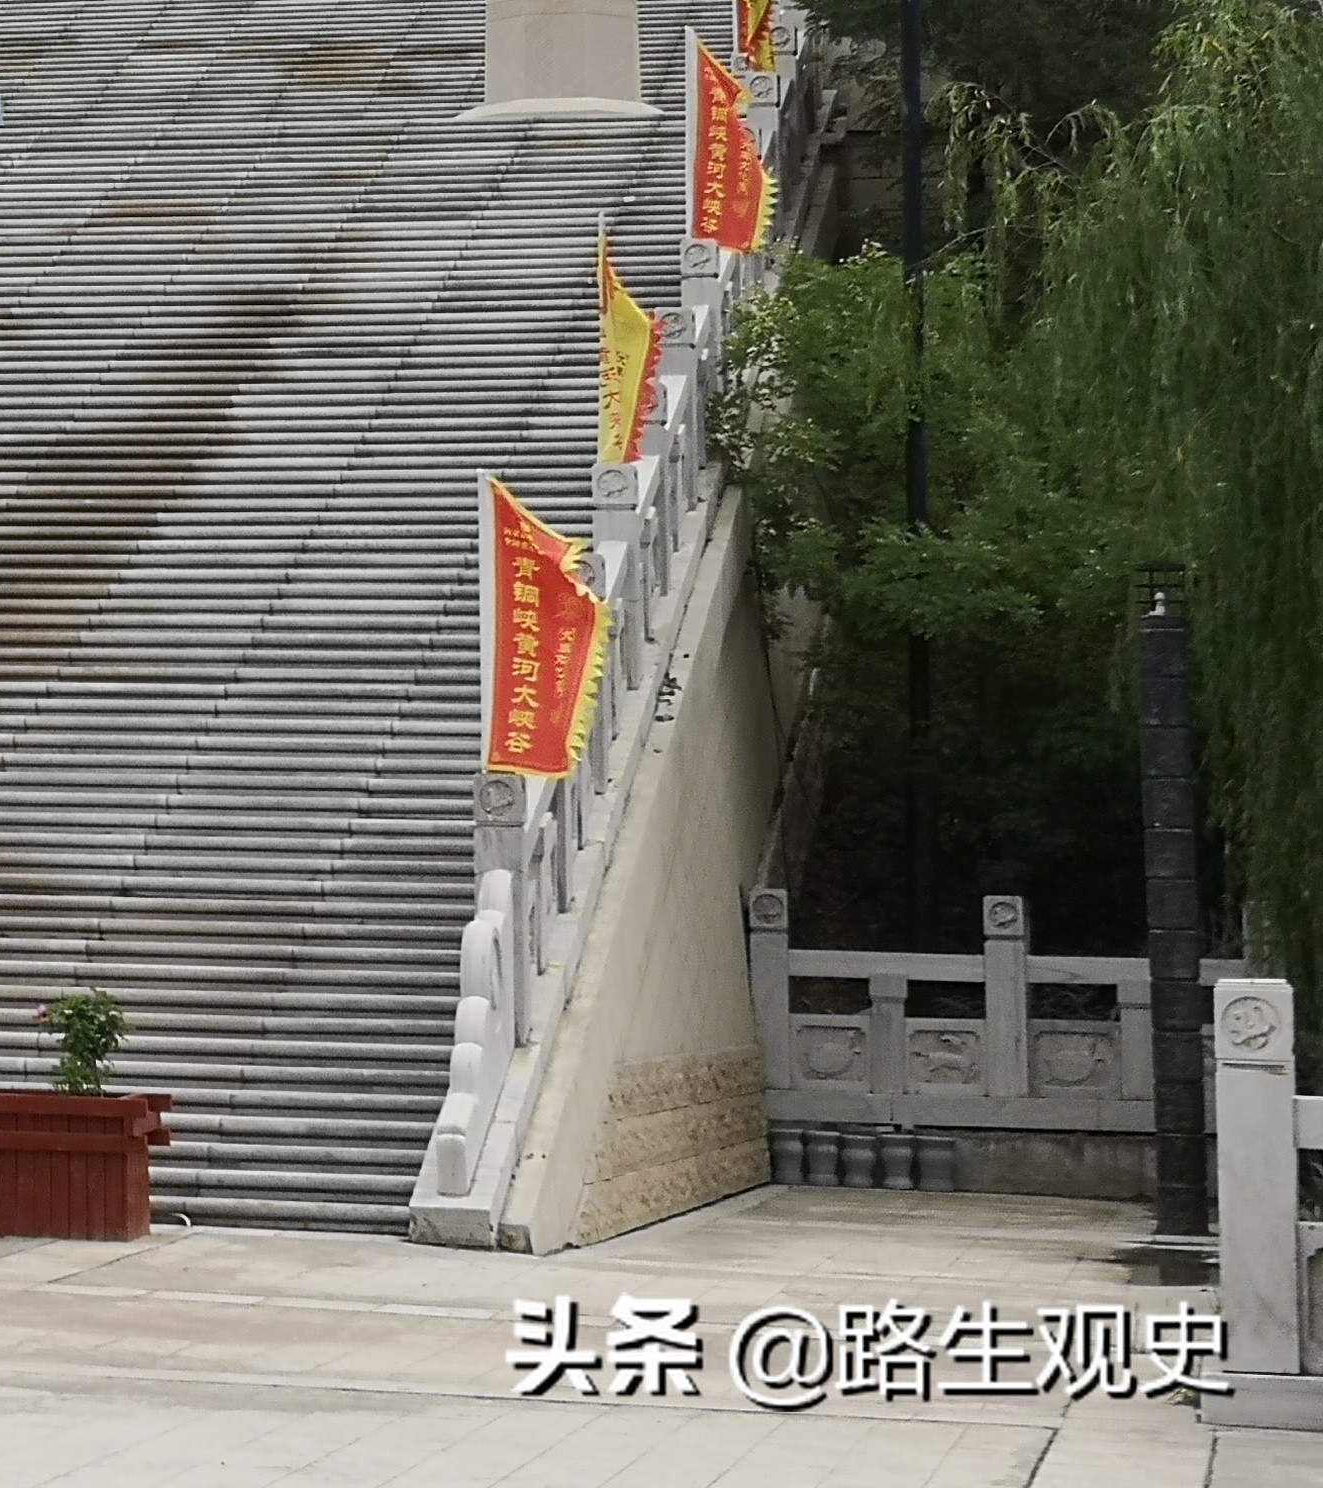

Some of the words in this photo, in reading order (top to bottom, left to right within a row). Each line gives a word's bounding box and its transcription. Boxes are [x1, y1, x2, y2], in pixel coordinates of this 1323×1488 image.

[504, 556, 540, 754] 青铜峡黄河大峡谷
